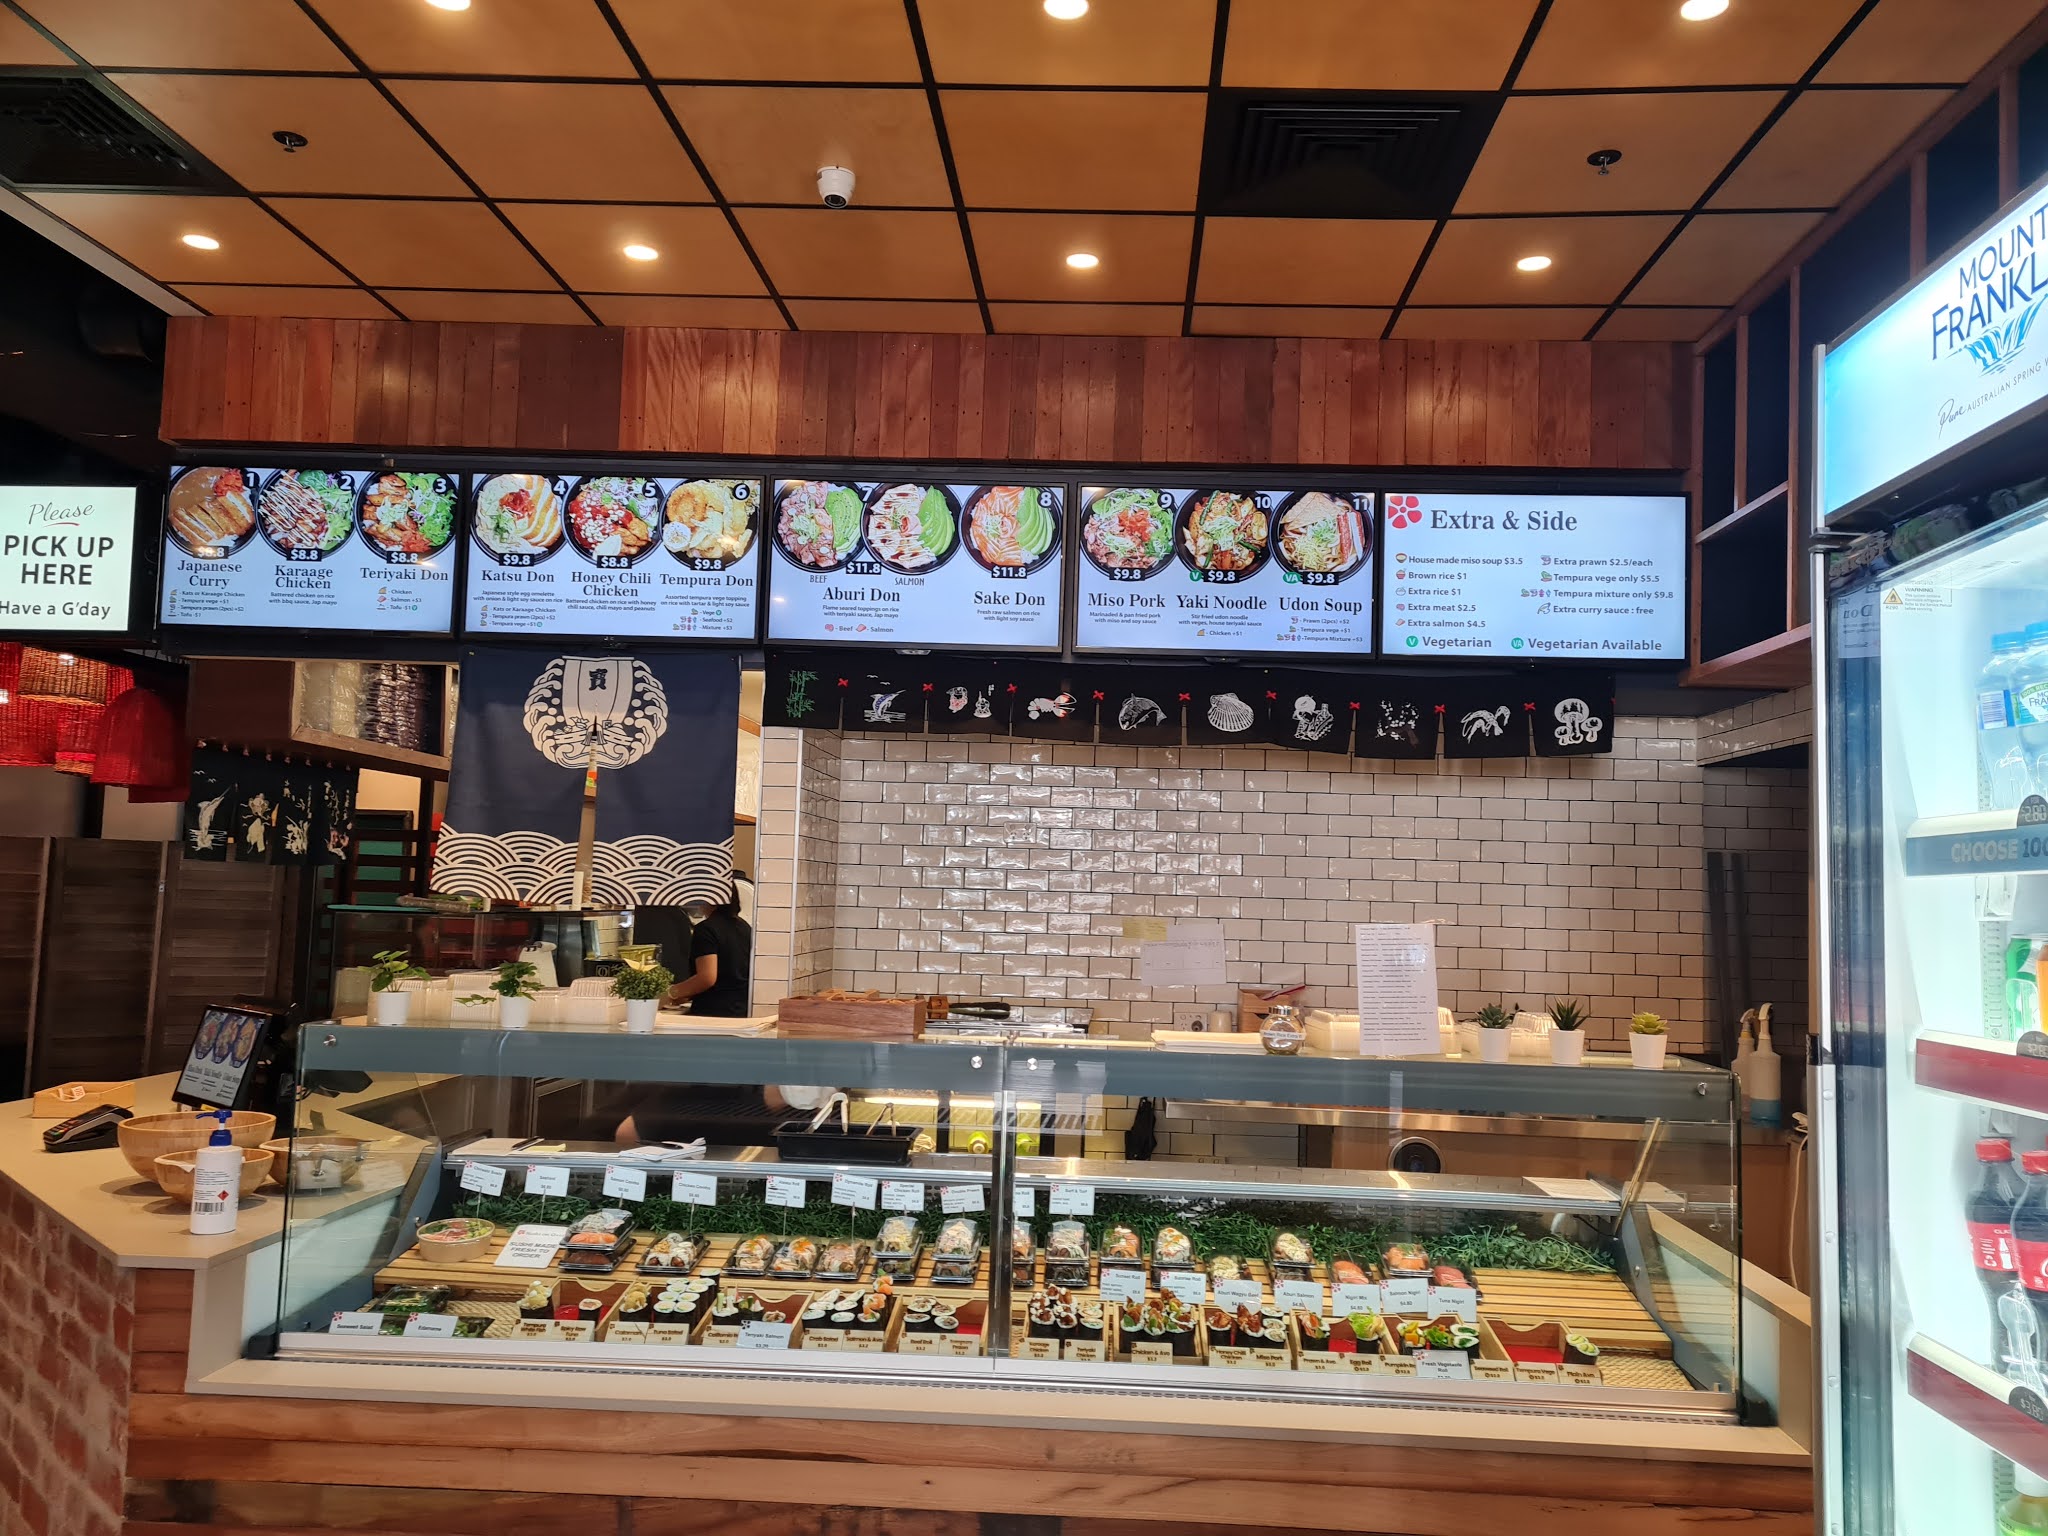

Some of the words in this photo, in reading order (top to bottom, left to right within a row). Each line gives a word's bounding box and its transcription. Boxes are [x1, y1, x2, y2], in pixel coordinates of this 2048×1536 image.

[1960, 203, 2048, 299] MOUNT
[1967, 382, 2012, 412] AUSTRALIAN
[2013, 362, 2042, 387] SPRING
[247, 473, 255, 486] 1
[341, 475, 352, 490] 2
[436, 479, 447, 493] 3
[553, 481, 566, 494] 4
[645, 482, 657, 497] 5
[735, 485, 747, 499] 6
[862, 487, 873, 501] 7
[1040, 492, 1052, 507] 8
[1161, 493, 1171, 507] 9
[1255, 496, 1270, 509] 10
[1353, 498, 1368, 511] 11
[28, 502, 95, 525] Please
[1430, 509, 1495, 530] Extra
[1502, 510, 1520, 530] &
[1528, 510, 1577, 531] Side
[4, 535, 68, 557] PICK
[77, 537, 114, 558] UP
[290, 549, 318, 561] $8.8
[391, 551, 418, 563] $8.8
[503, 554, 531, 566] $9.8
[1408, 555, 1435, 564] House
[1436, 556, 1460, 564] made
[1461, 556, 1481, 565] miso
[1482, 558, 1503, 566] soup
[1504, 557, 1523, 565] $3.5
[178, 560, 242, 574] Japanese
[601, 556, 628, 568] $8.8
[694, 559, 722, 570] $9.8
[847, 562, 881, 574] $11.8
[1554, 558, 1577, 566] Extra
[1579, 559, 1608, 567] prawn
[1609, 558, 1653, 567] $2.5/each
[21, 563, 93, 585] HERE
[274, 565, 333, 579] Karaage
[360, 568, 417, 582] Teriyaki
[421, 571, 449, 582] Don
[481, 570, 522, 582] Katsu
[527, 571, 555, 583] Don
[571, 571, 615, 586] Honey
[619, 572, 652, 584] Chili
[992, 566, 1027, 578] $11.8
[1114, 568, 1141, 580] $9.8
[1208, 569, 1236, 582] $9.8
[1285, 574, 1298, 582] VA
[1307, 572, 1335, 584] $9.8
[1408, 572, 1437, 580] Brown
[1439, 572, 1455, 580] rice
[1457, 572, 1467, 580] $1
[1553, 573, 1593, 583] Tempura
[1618, 575, 1639, 583] only
[1640, 575, 1660, 583] $5.5
[189, 575, 230, 590] Curry
[275, 576, 331, 590] Chicken
[660, 574, 721, 588] Tempura
[726, 575, 754, 587] Don
[810, 575, 828, 584] BEEF
[895, 577, 925, 586] SALMON
[583, 584, 638, 597] Chicken
[822, 587, 865, 601] Aburi
[870, 588, 901, 602] Don
[1408, 587, 1431, 595] Extra
[1451, 588, 1461, 596] $1
[1553, 589, 1593, 599] Tempura
[1595, 590, 1630, 599] mixture
[1632, 591, 1652, 600] only
[1654, 591, 1674, 599] $9.8
[974, 590, 1011, 605] Sake
[1015, 591, 1046, 606] Don
[1088, 592, 1125, 607] Miso
[1129, 593, 1166, 608] Pork
[1176, 595, 1209, 609] Yaki
[1213, 595, 1267, 610] Noodle
[0, 601, 42, 615] Have
[47, 605, 56, 615] a
[62, 602, 111, 620] G'day
[1279, 597, 1319, 611] Udon
[1324, 597, 1363, 615] Soup
[1458, 604, 1477, 612] $2.5
[1578, 607, 1602, 616] curry
[1636, 606, 1654, 614] free
[1407, 619, 1431, 627] Extra
[1467, 620, 1486, 628] $4.5
[1422, 636, 1492, 649] Vegetarian
[1528, 638, 1598, 652] Vegetarian
[1602, 639, 1662, 651] Available
[1950, 839, 2018, 863] CHOOSE
